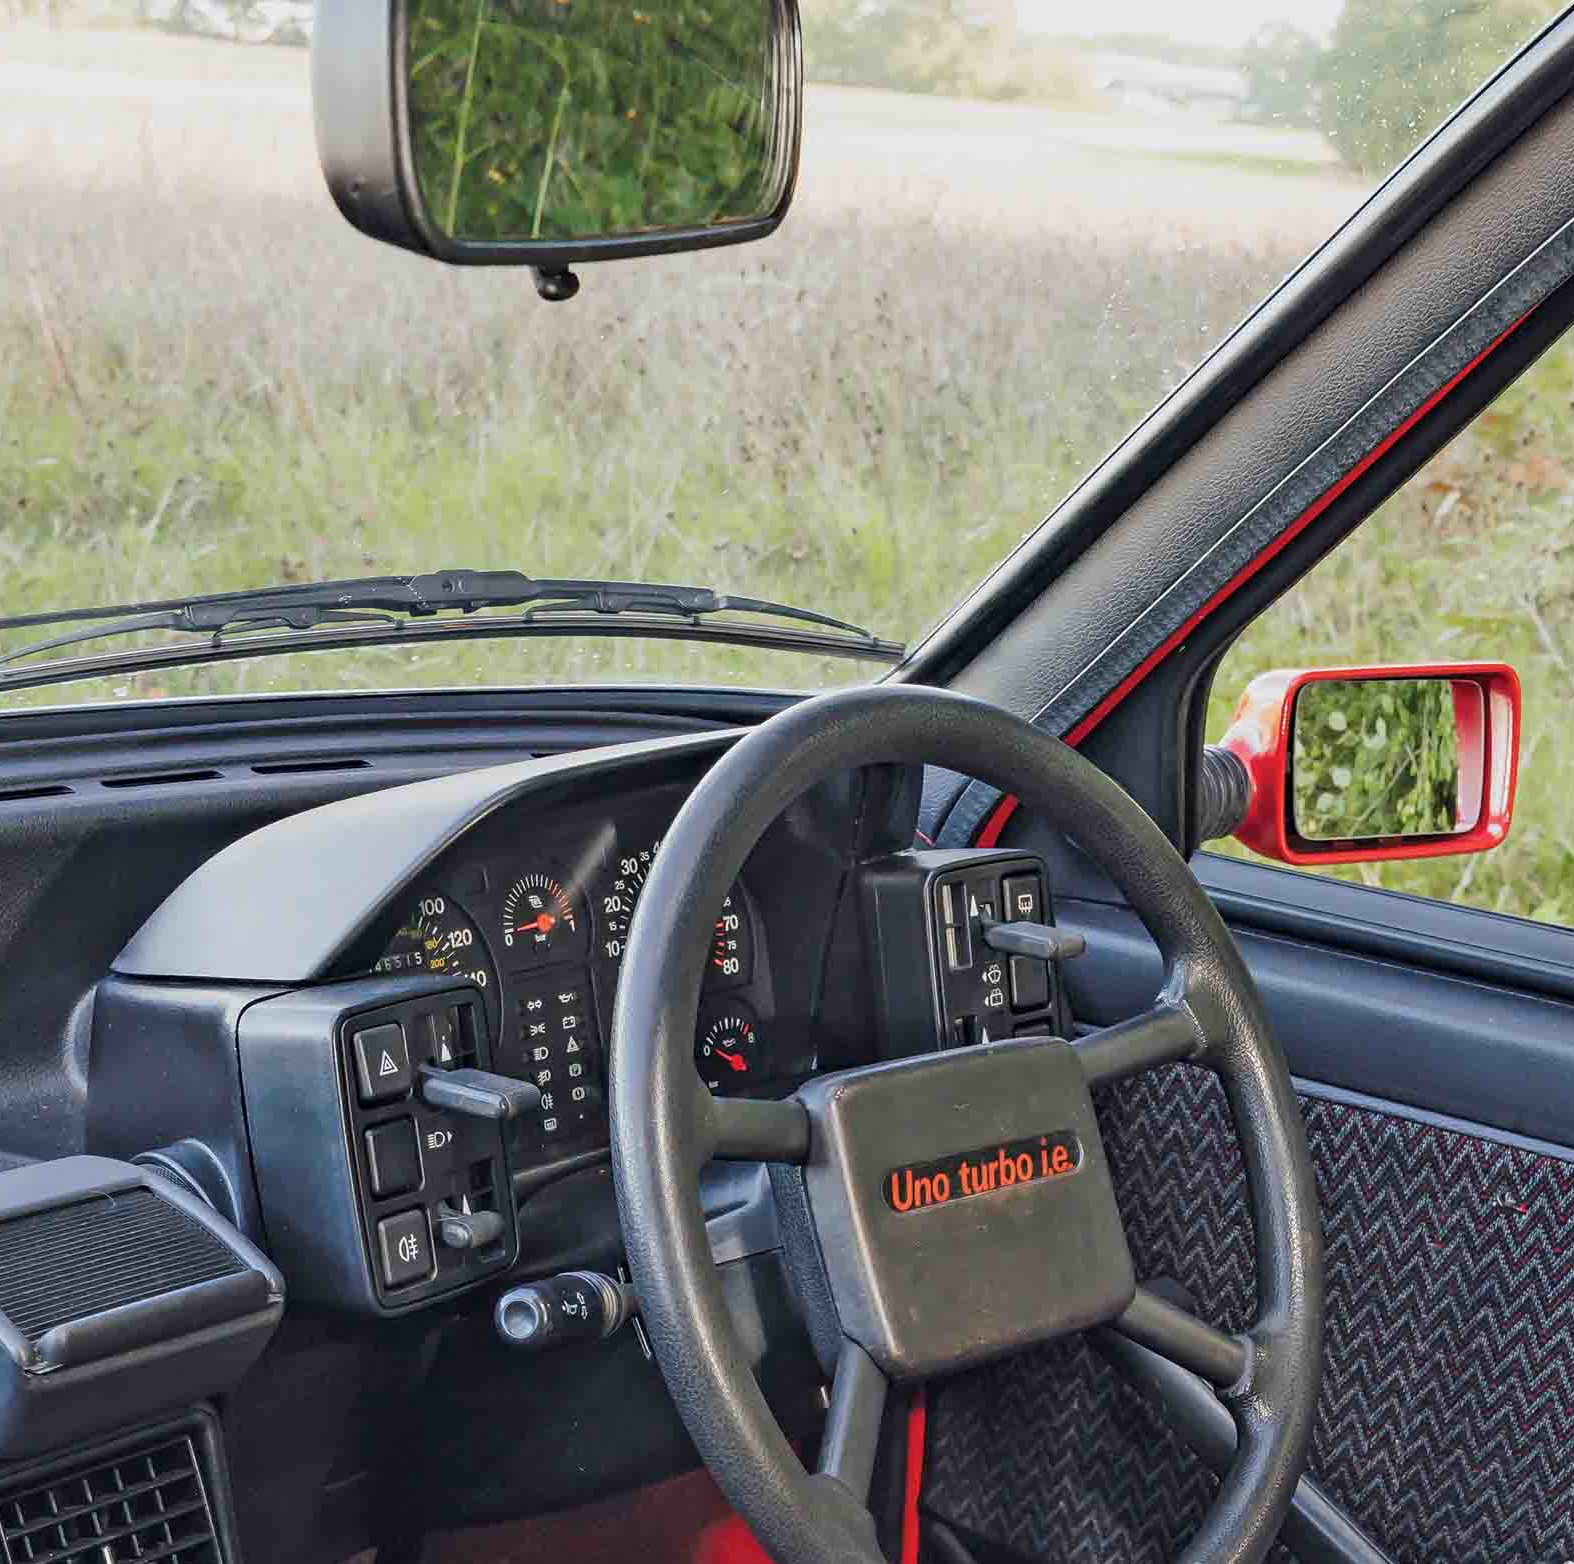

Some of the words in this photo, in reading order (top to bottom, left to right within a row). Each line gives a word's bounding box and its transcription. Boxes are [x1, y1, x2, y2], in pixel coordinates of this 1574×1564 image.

[621, 857, 638, 875] 30
[615, 879, 625, 891] 25
[418, 898, 444, 916] 100
[604, 896, 621, 913] 20
[723, 915, 739, 931] 70
[447, 929, 473, 948] 120
[505, 934, 514, 947] 0
[606, 941, 620, 957] 10
[723, 957, 739, 975] 80
[703, 1045, 711, 1056] 0
[891, 1169, 950, 1212] Uno
[959, 1150, 1033, 1195] turbo
